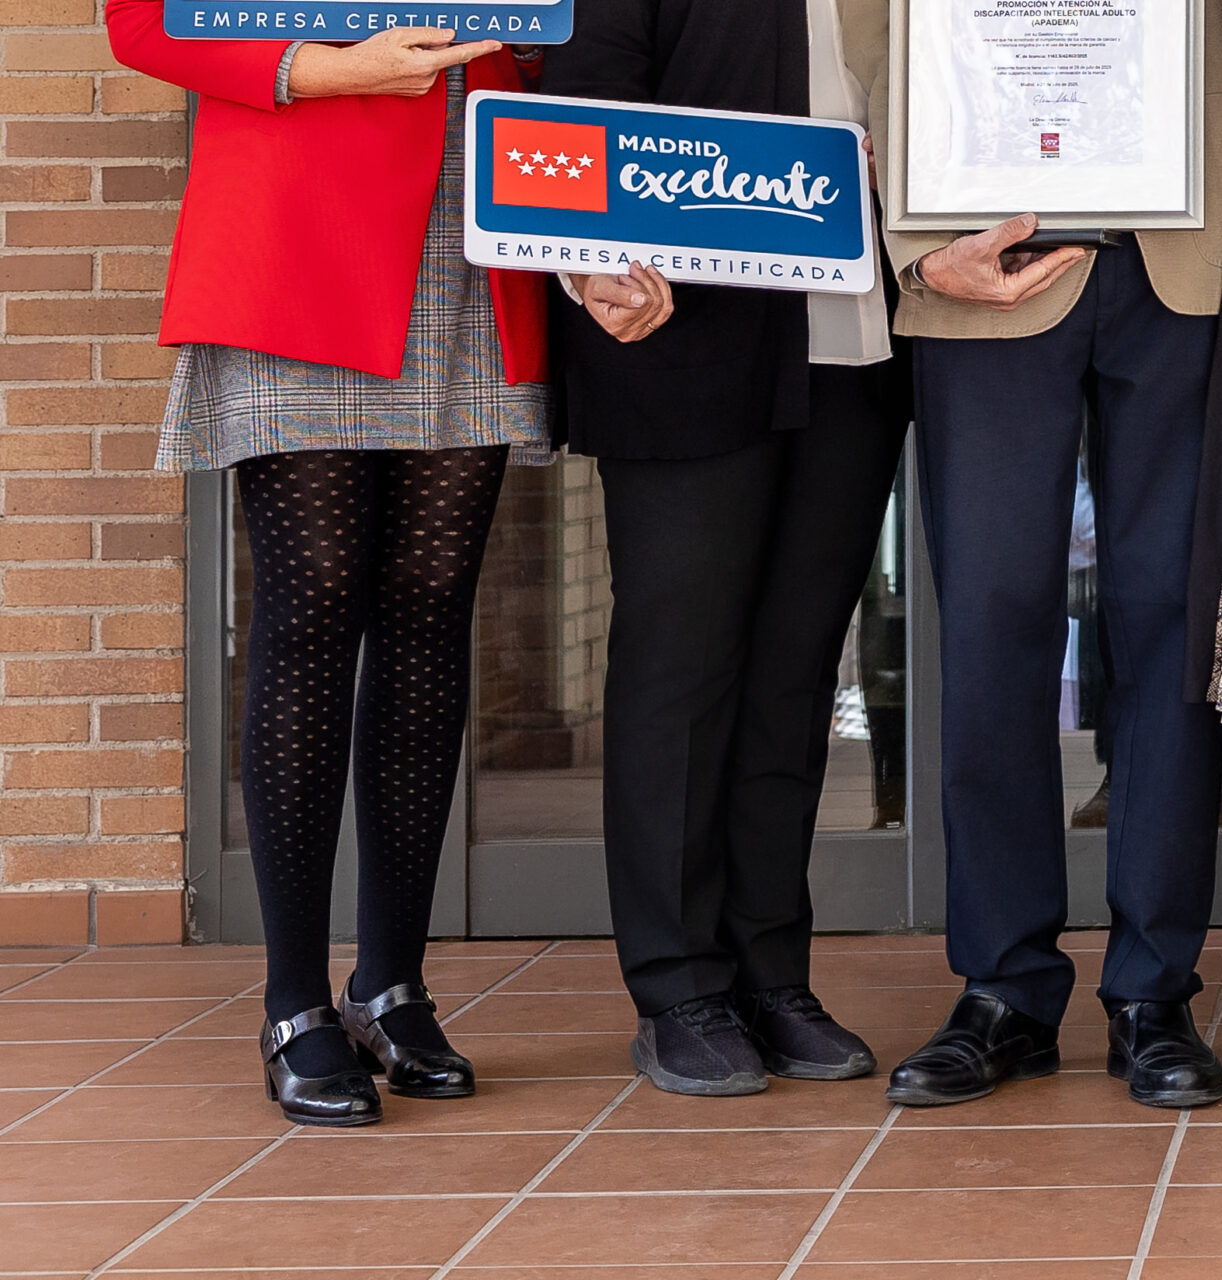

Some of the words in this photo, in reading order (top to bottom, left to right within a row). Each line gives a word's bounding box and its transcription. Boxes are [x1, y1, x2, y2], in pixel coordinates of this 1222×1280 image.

[974, 9, 1042, 17] DISCAPACITADO
[1044, 9, 1100, 17] INTELECTUAL
[1102, 9, 1136, 17] ADULTO
[997, 0, 1048, 8] PROMOCIÓN
[1057, 0, 1100, 8] ATENCIÓN
[1102, 0, 1113, 8] AL
[194, 11, 327, 29] EMPRESA
[346, 13, 542, 32] CERTIFICADA
[1031, 19, 1079, 28] (APADEMA)
[618, 134, 721, 158] MADRID
[619, 155, 840, 210] excelente
[497, 242, 631, 264] EMPRESA
[650, 254, 845, 282] CERTIFICADA
